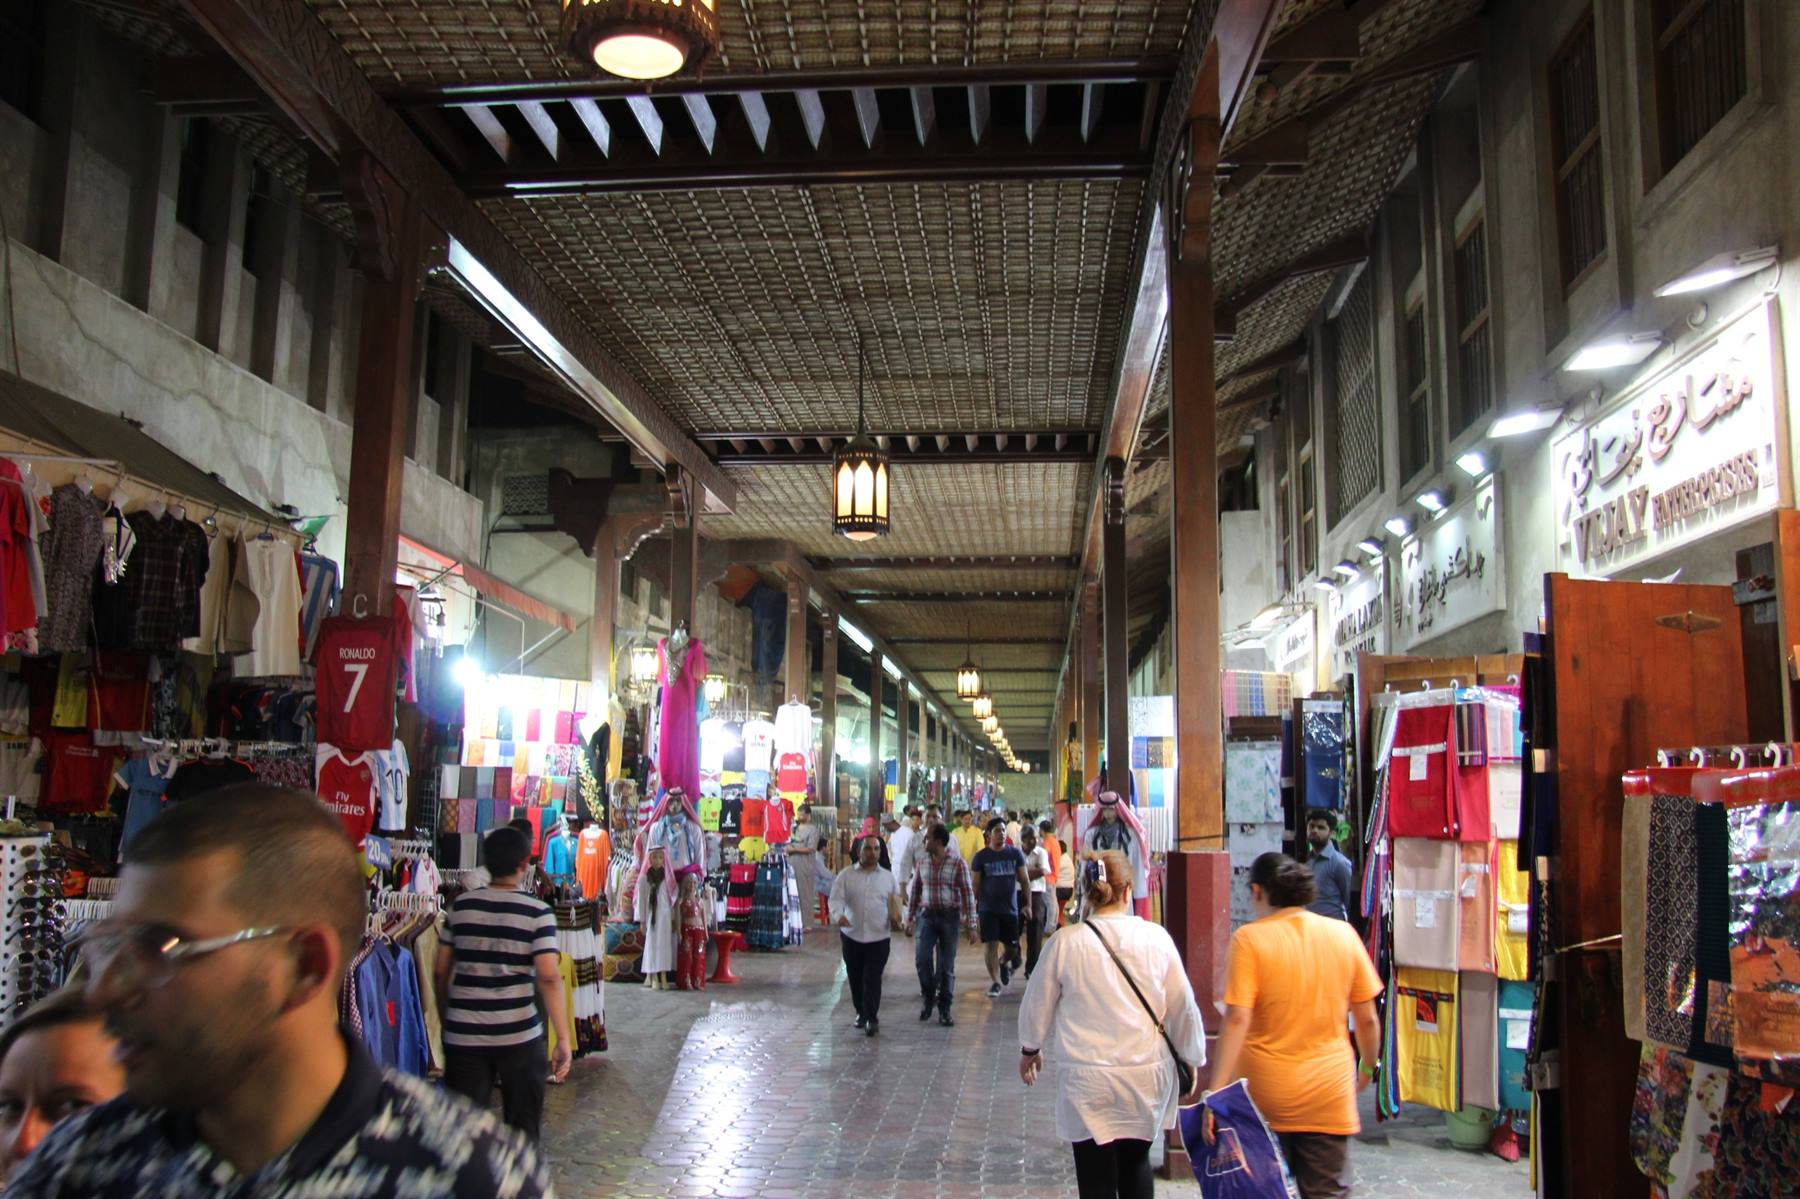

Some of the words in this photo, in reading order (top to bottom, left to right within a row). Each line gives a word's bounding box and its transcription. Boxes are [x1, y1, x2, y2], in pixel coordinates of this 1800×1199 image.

[1573, 484, 1649, 563] VIJAY
[1652, 449, 1759, 531] ENTERPRISES
[339, 648, 376, 660] RONALDO
[343, 663, 369, 713] 7
[336, 791, 350, 803] Fly
[385, 768, 404, 805] 10
[324, 801, 366, 816] mirates
